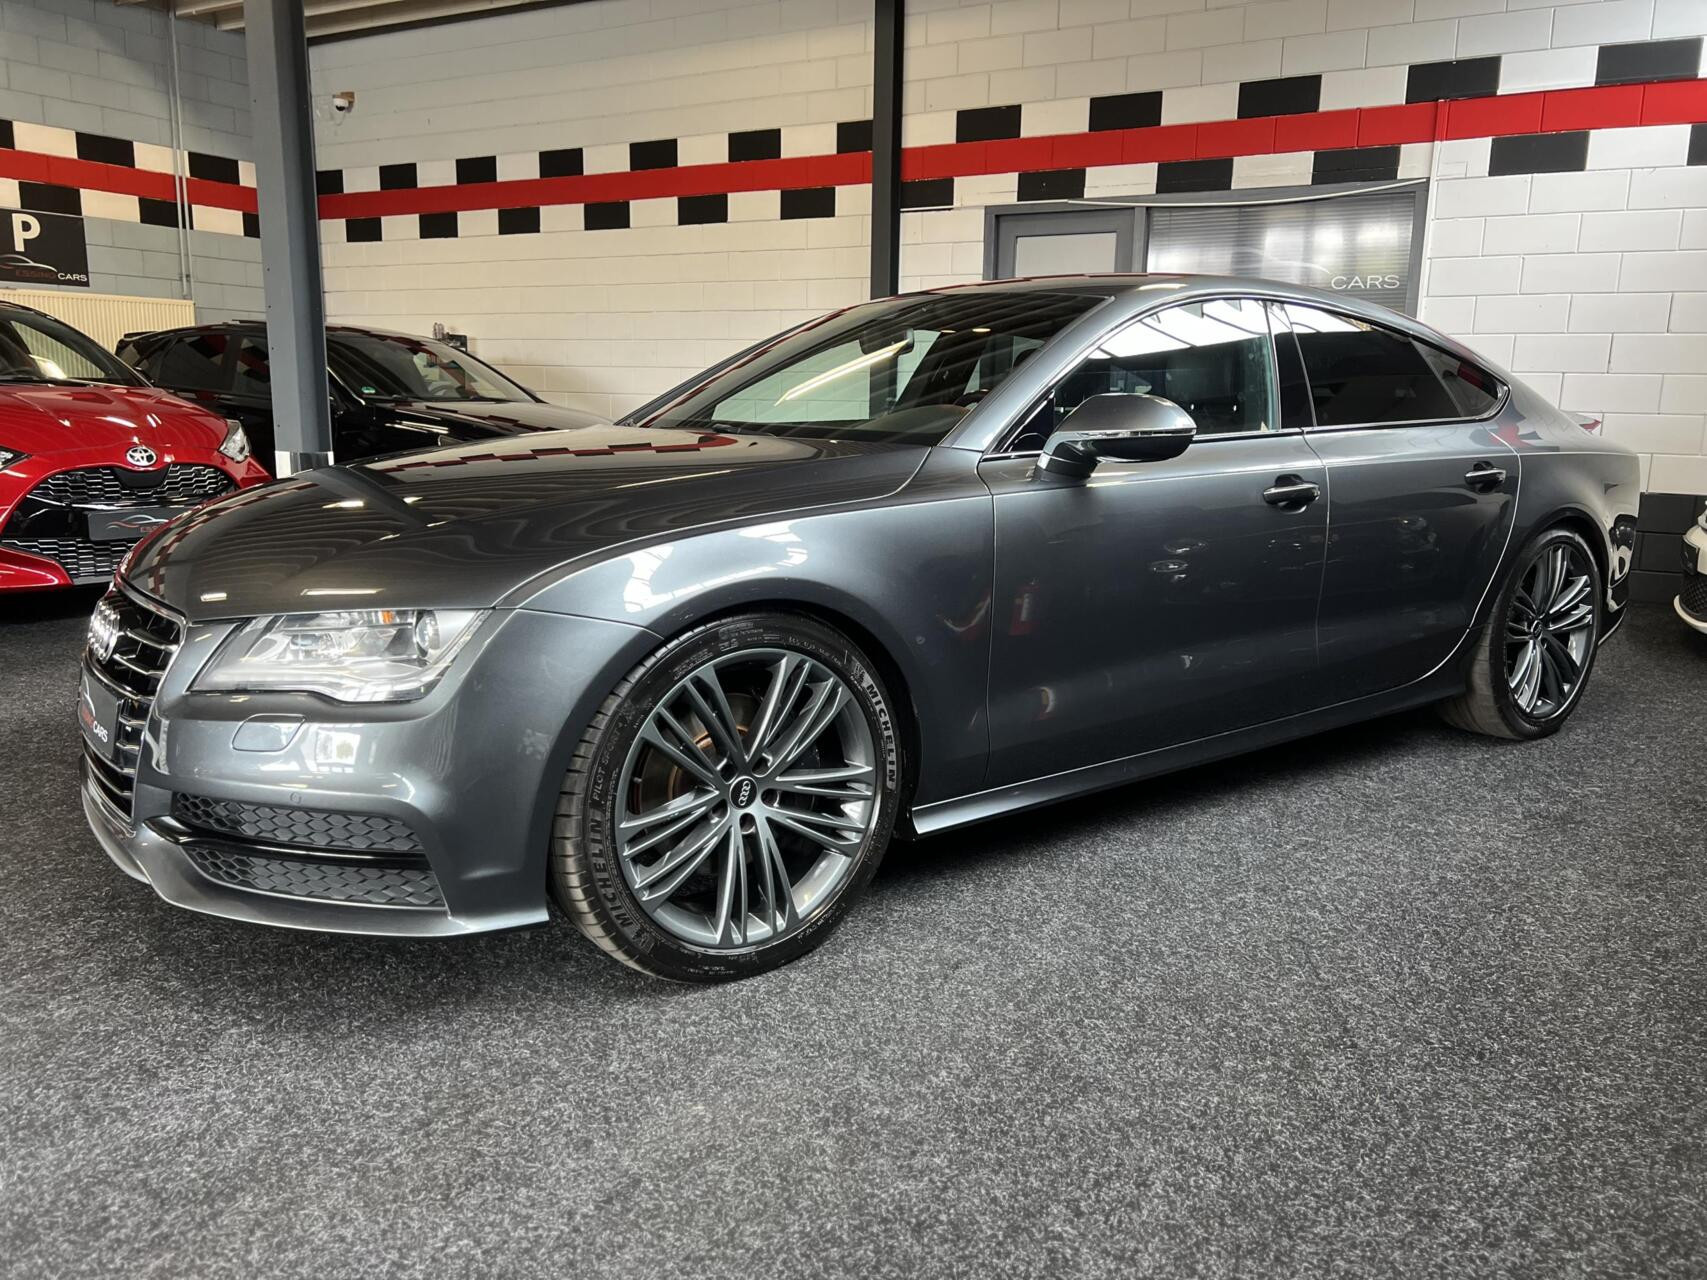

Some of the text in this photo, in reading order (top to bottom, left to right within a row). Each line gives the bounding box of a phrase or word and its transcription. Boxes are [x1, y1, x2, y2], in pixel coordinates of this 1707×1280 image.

[12, 213, 41, 252] P
[57, 273, 88, 282] CARS
[1331, 274, 1400, 290] CARS
[93, 720, 108, 742] CARS
[866, 683, 896, 783] MICHELIN
[592, 766, 606, 801] PILOT
[590, 817, 634, 929] MICHELIN
